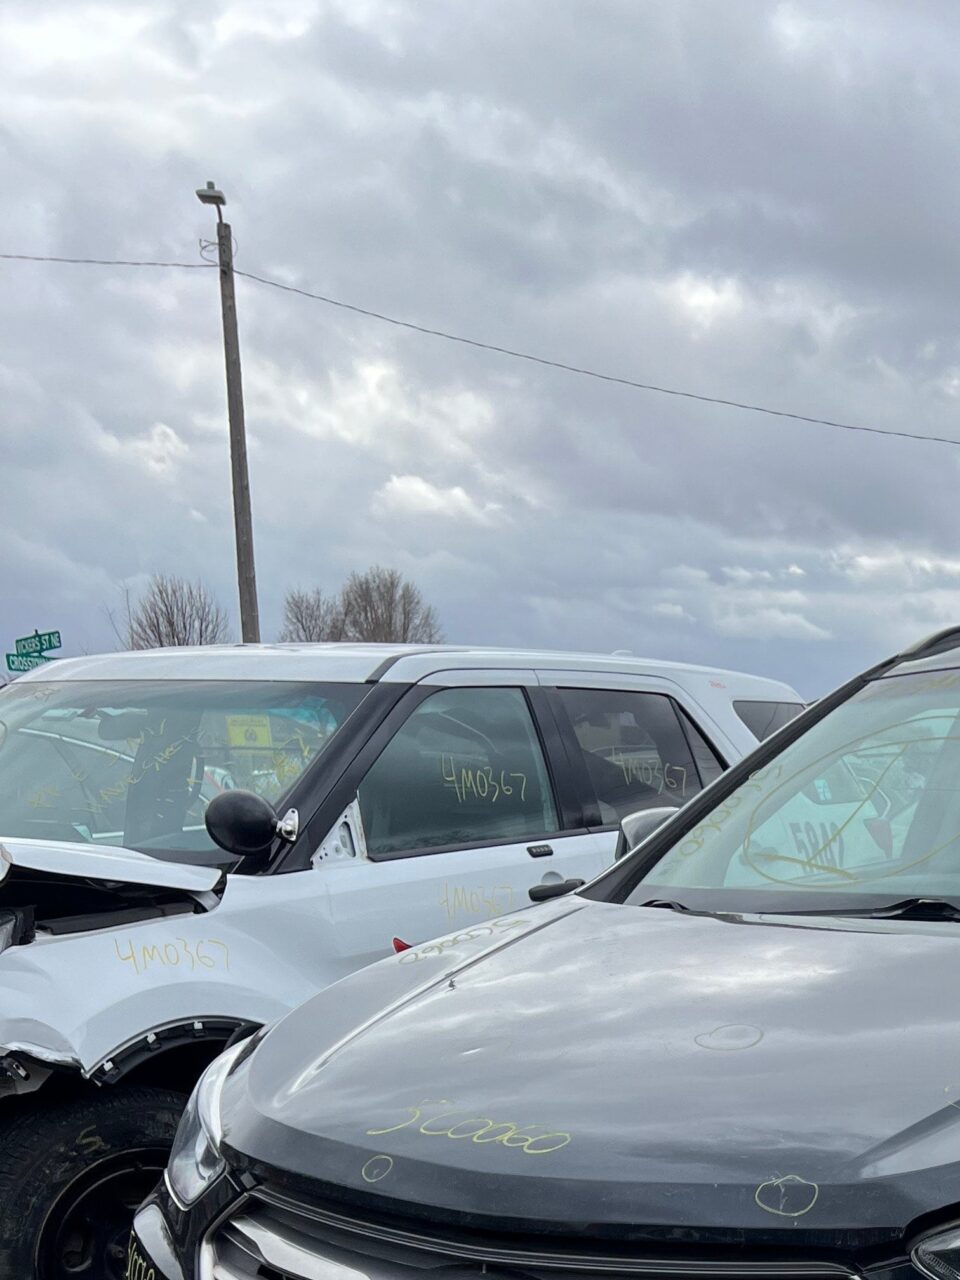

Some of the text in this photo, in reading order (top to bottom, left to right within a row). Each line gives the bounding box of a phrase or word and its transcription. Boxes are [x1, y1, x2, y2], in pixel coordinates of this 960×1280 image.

[41, 634, 50, 650] ST
[50, 632, 60, 648] NE
[9, 655, 50, 670] CROSSTO
[441, 752, 528, 804] 4M0367
[611, 745, 688, 797] 4M0367
[114, 937, 231, 975] 4M0367
